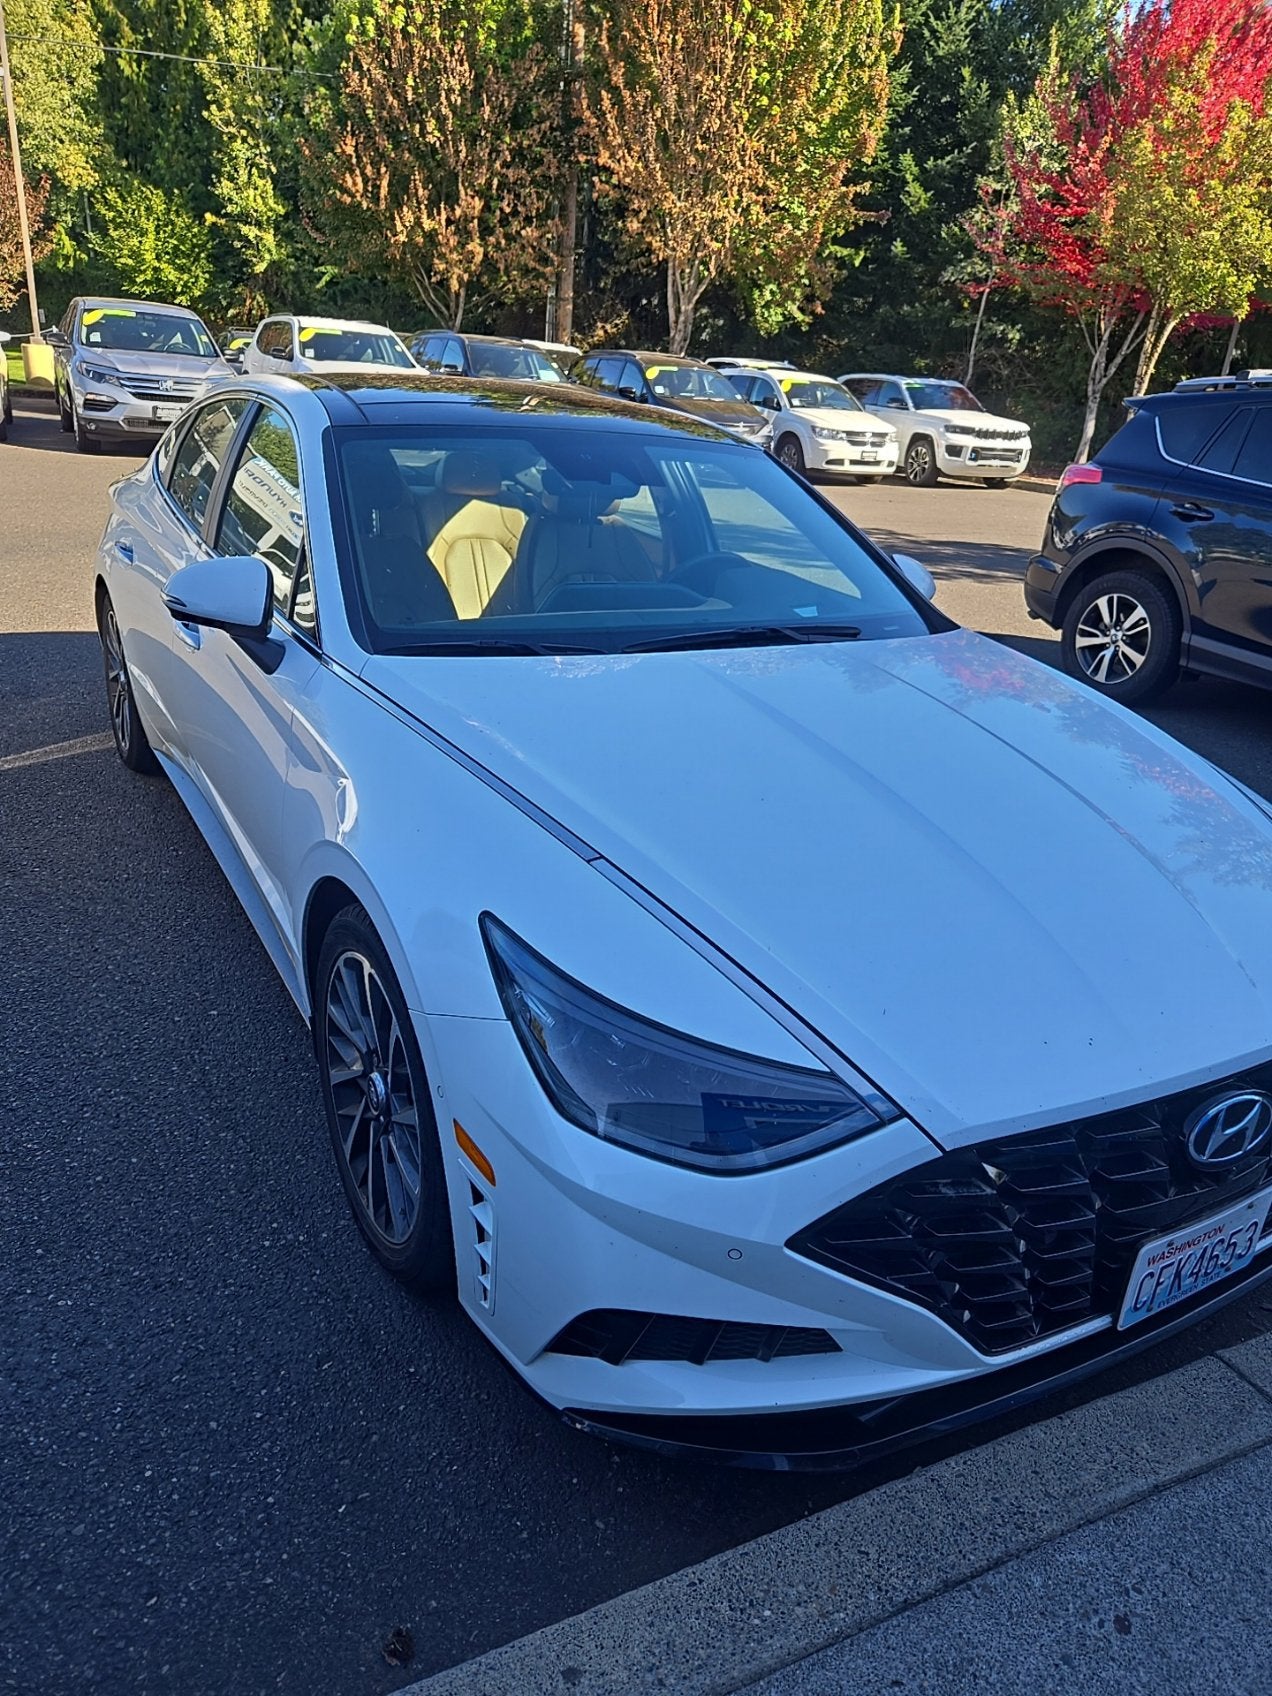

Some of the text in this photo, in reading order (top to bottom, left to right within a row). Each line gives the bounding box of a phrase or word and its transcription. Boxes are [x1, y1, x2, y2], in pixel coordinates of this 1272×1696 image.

[1132, 1220, 1259, 1312] CFK4653
[1147, 1223, 1226, 1267] WASHINGTON
[1200, 1271, 1222, 1287] STATE
